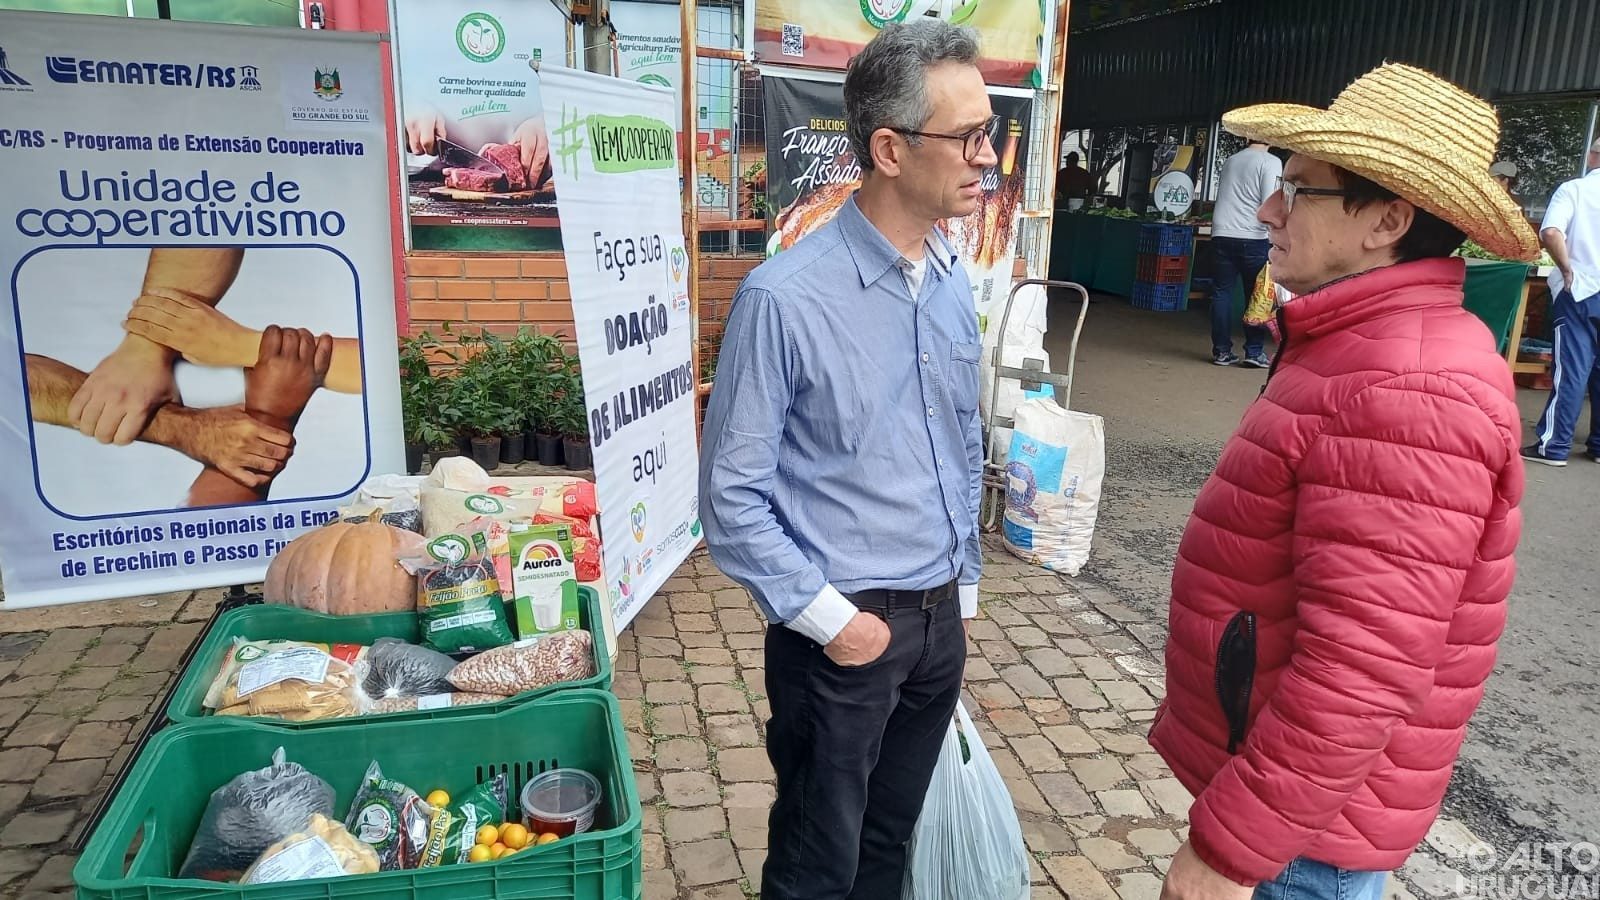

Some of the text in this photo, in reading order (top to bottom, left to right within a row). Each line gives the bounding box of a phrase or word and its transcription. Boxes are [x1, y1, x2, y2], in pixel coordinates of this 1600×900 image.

[79, 61, 235, 88] EMATER/RS
[439, 76, 465, 86] Carne
[466, 77, 495, 88] bovina
[440, 86, 526, 98] da melhor qualidade
[461, 100, 508, 117] aqui tem
[64, 131, 153, 152] Programa
[158, 134, 180, 151] de
[185, 134, 262, 154] Extensão
[267, 137, 364, 156] Cooperativa
[781, 125, 850, 165] Frango
[59, 169, 300, 202] Unidade de
[791, 156, 862, 190] Assado
[15, 202, 346, 246] cooperativismo
[593, 231, 661, 281] Faça sua
[603, 294, 668, 356] DOAÇÃO
[591, 360, 693, 447] DE ALIMENTOS
[632, 430, 667, 485] aqui
[53, 510, 339, 551] Escritórios Regionais da Ema
[61, 559, 87, 577] de
[94, 549, 177, 575] Erechim
[184, 551, 196, 565] e
[202, 543, 259, 563] Passo
[523, 558, 562, 570] Aurora
[429, 590, 459, 603] Feijão
